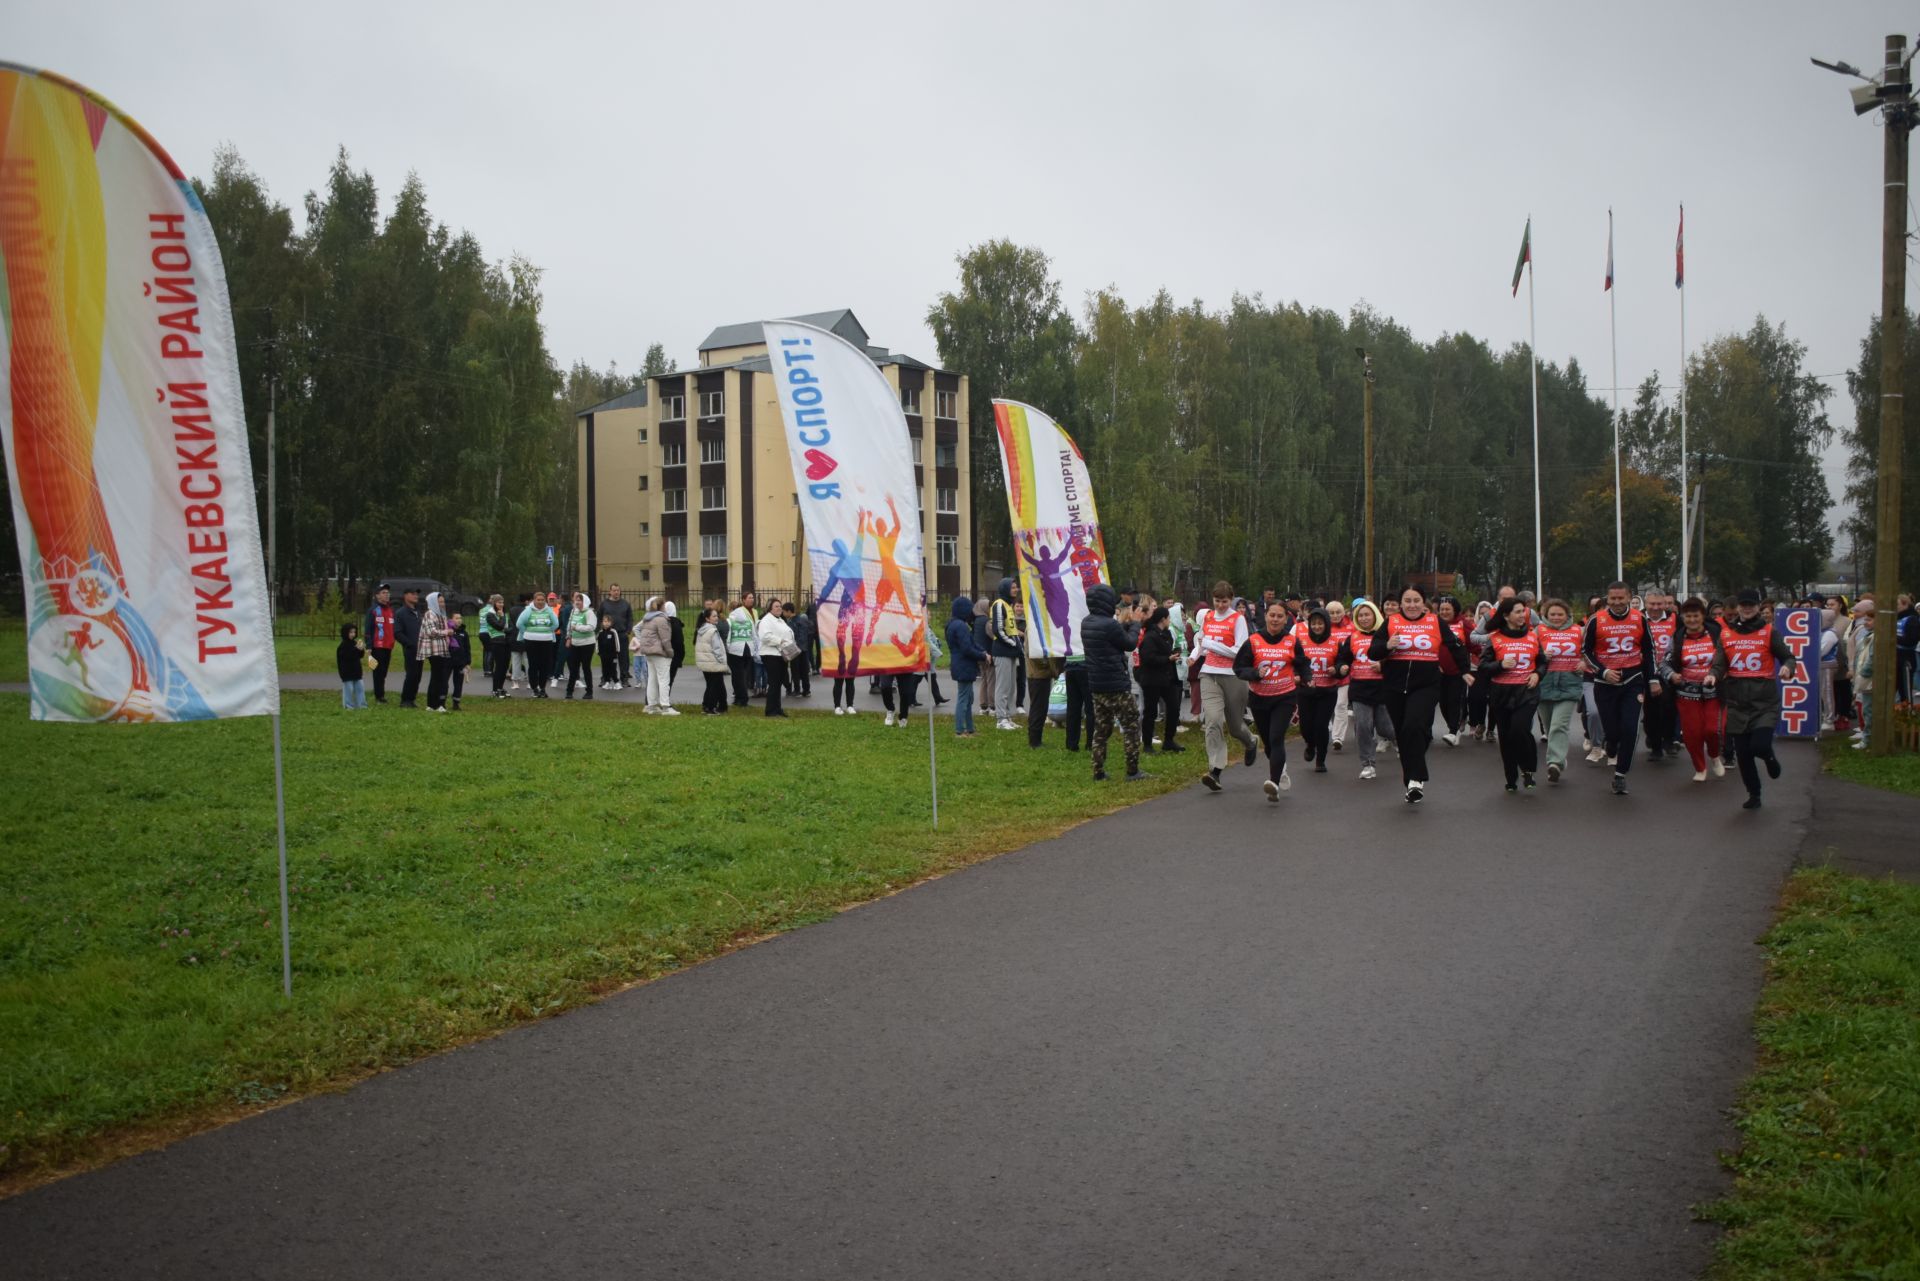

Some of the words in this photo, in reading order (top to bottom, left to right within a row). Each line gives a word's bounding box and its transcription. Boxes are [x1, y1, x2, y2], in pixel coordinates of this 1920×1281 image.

[144, 212, 204, 359] РАЙОН
[781, 338, 831, 447] СПОРТ!
[1059, 449, 1078, 501] СПОРТА!
[808, 481, 842, 501] Я
[156, 382, 237, 663] ТУКАЕВСКИЙ
[1397, 634, 1432, 650] 56
[1546, 642, 1577, 656] 52
[1605, 636, 1635, 653] 36
[1310, 656, 1328, 671] 41
[1683, 653, 1713, 668] 27
[1730, 652, 1762, 671] 46
[1781, 610, 1811, 734] СТАРТ
